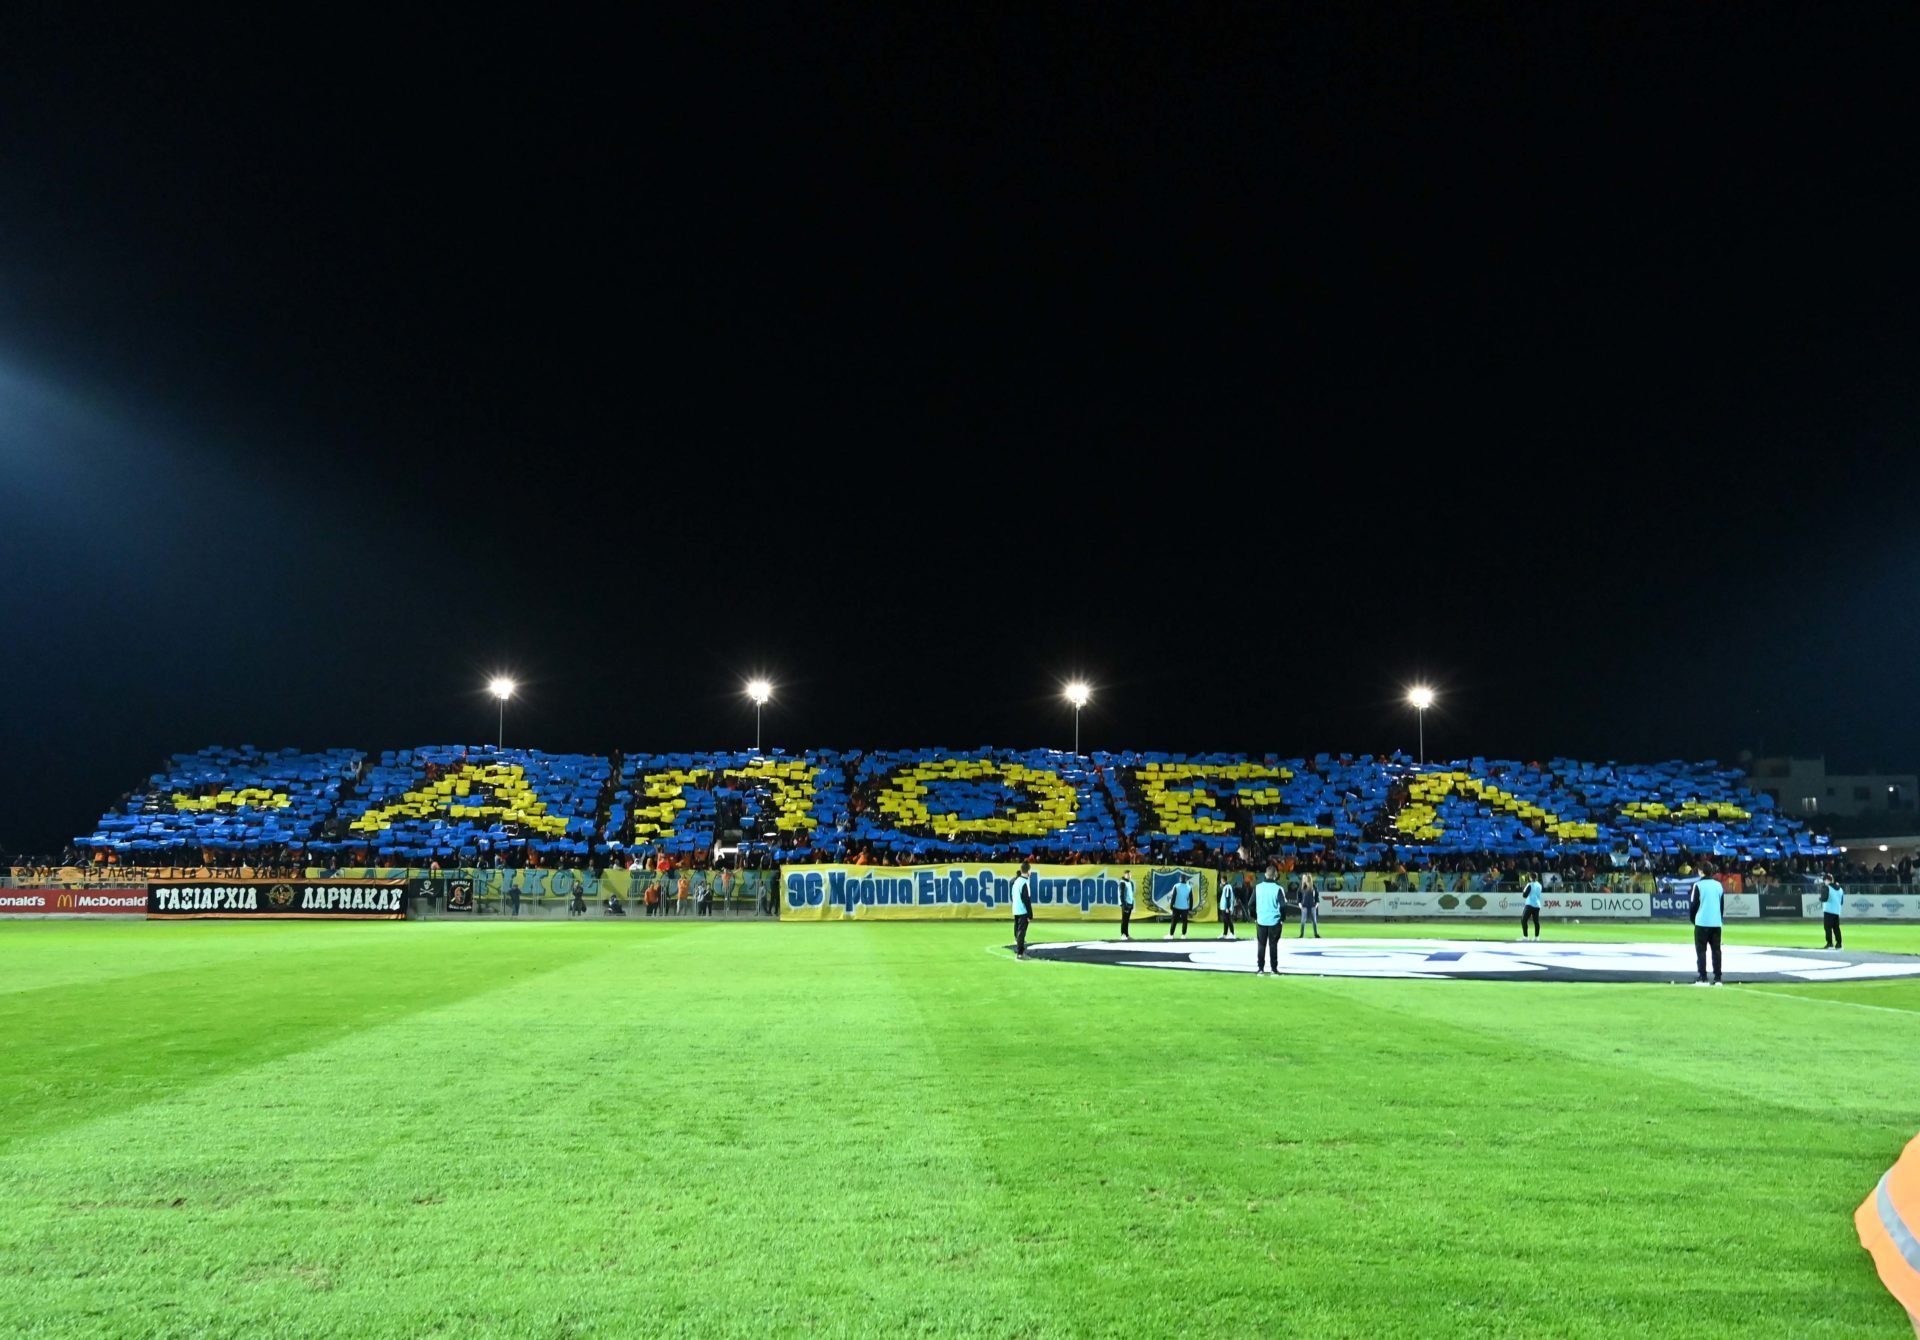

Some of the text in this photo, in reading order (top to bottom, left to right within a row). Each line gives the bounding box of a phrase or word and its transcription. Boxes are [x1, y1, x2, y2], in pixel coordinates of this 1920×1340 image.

[787, 870, 1121, 912] 96 Χρόνια Ένδοξη Ιστορία
[156, 887, 258, 910] ΤΑΞΙΑΡΧΙΑ
[302, 887, 403, 911] ΛΑΡΝΑΚΑΣ
[1544, 900, 1562, 908] SYM
[1565, 900, 1583, 908] SYM
[1591, 898, 1643, 911] DIMCO
[1652, 897, 1690, 909] bet on
